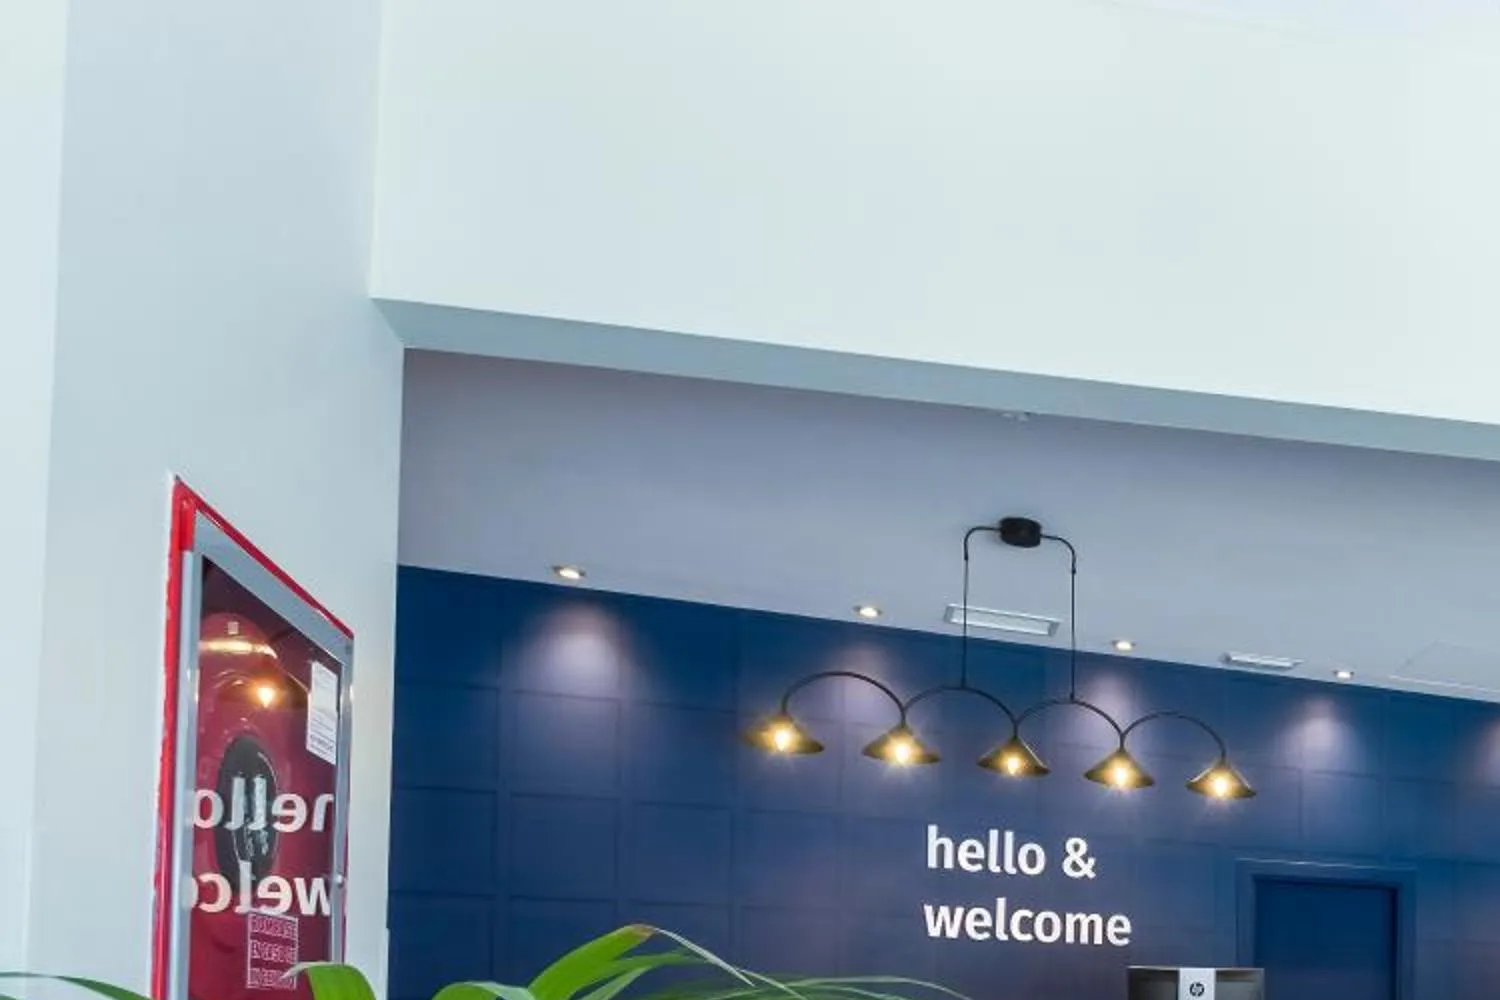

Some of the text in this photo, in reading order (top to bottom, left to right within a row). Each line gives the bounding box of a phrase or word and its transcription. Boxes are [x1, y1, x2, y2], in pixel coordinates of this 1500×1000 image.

[927, 823, 1097, 880] hello &
[923, 897, 1133, 947] welcome
